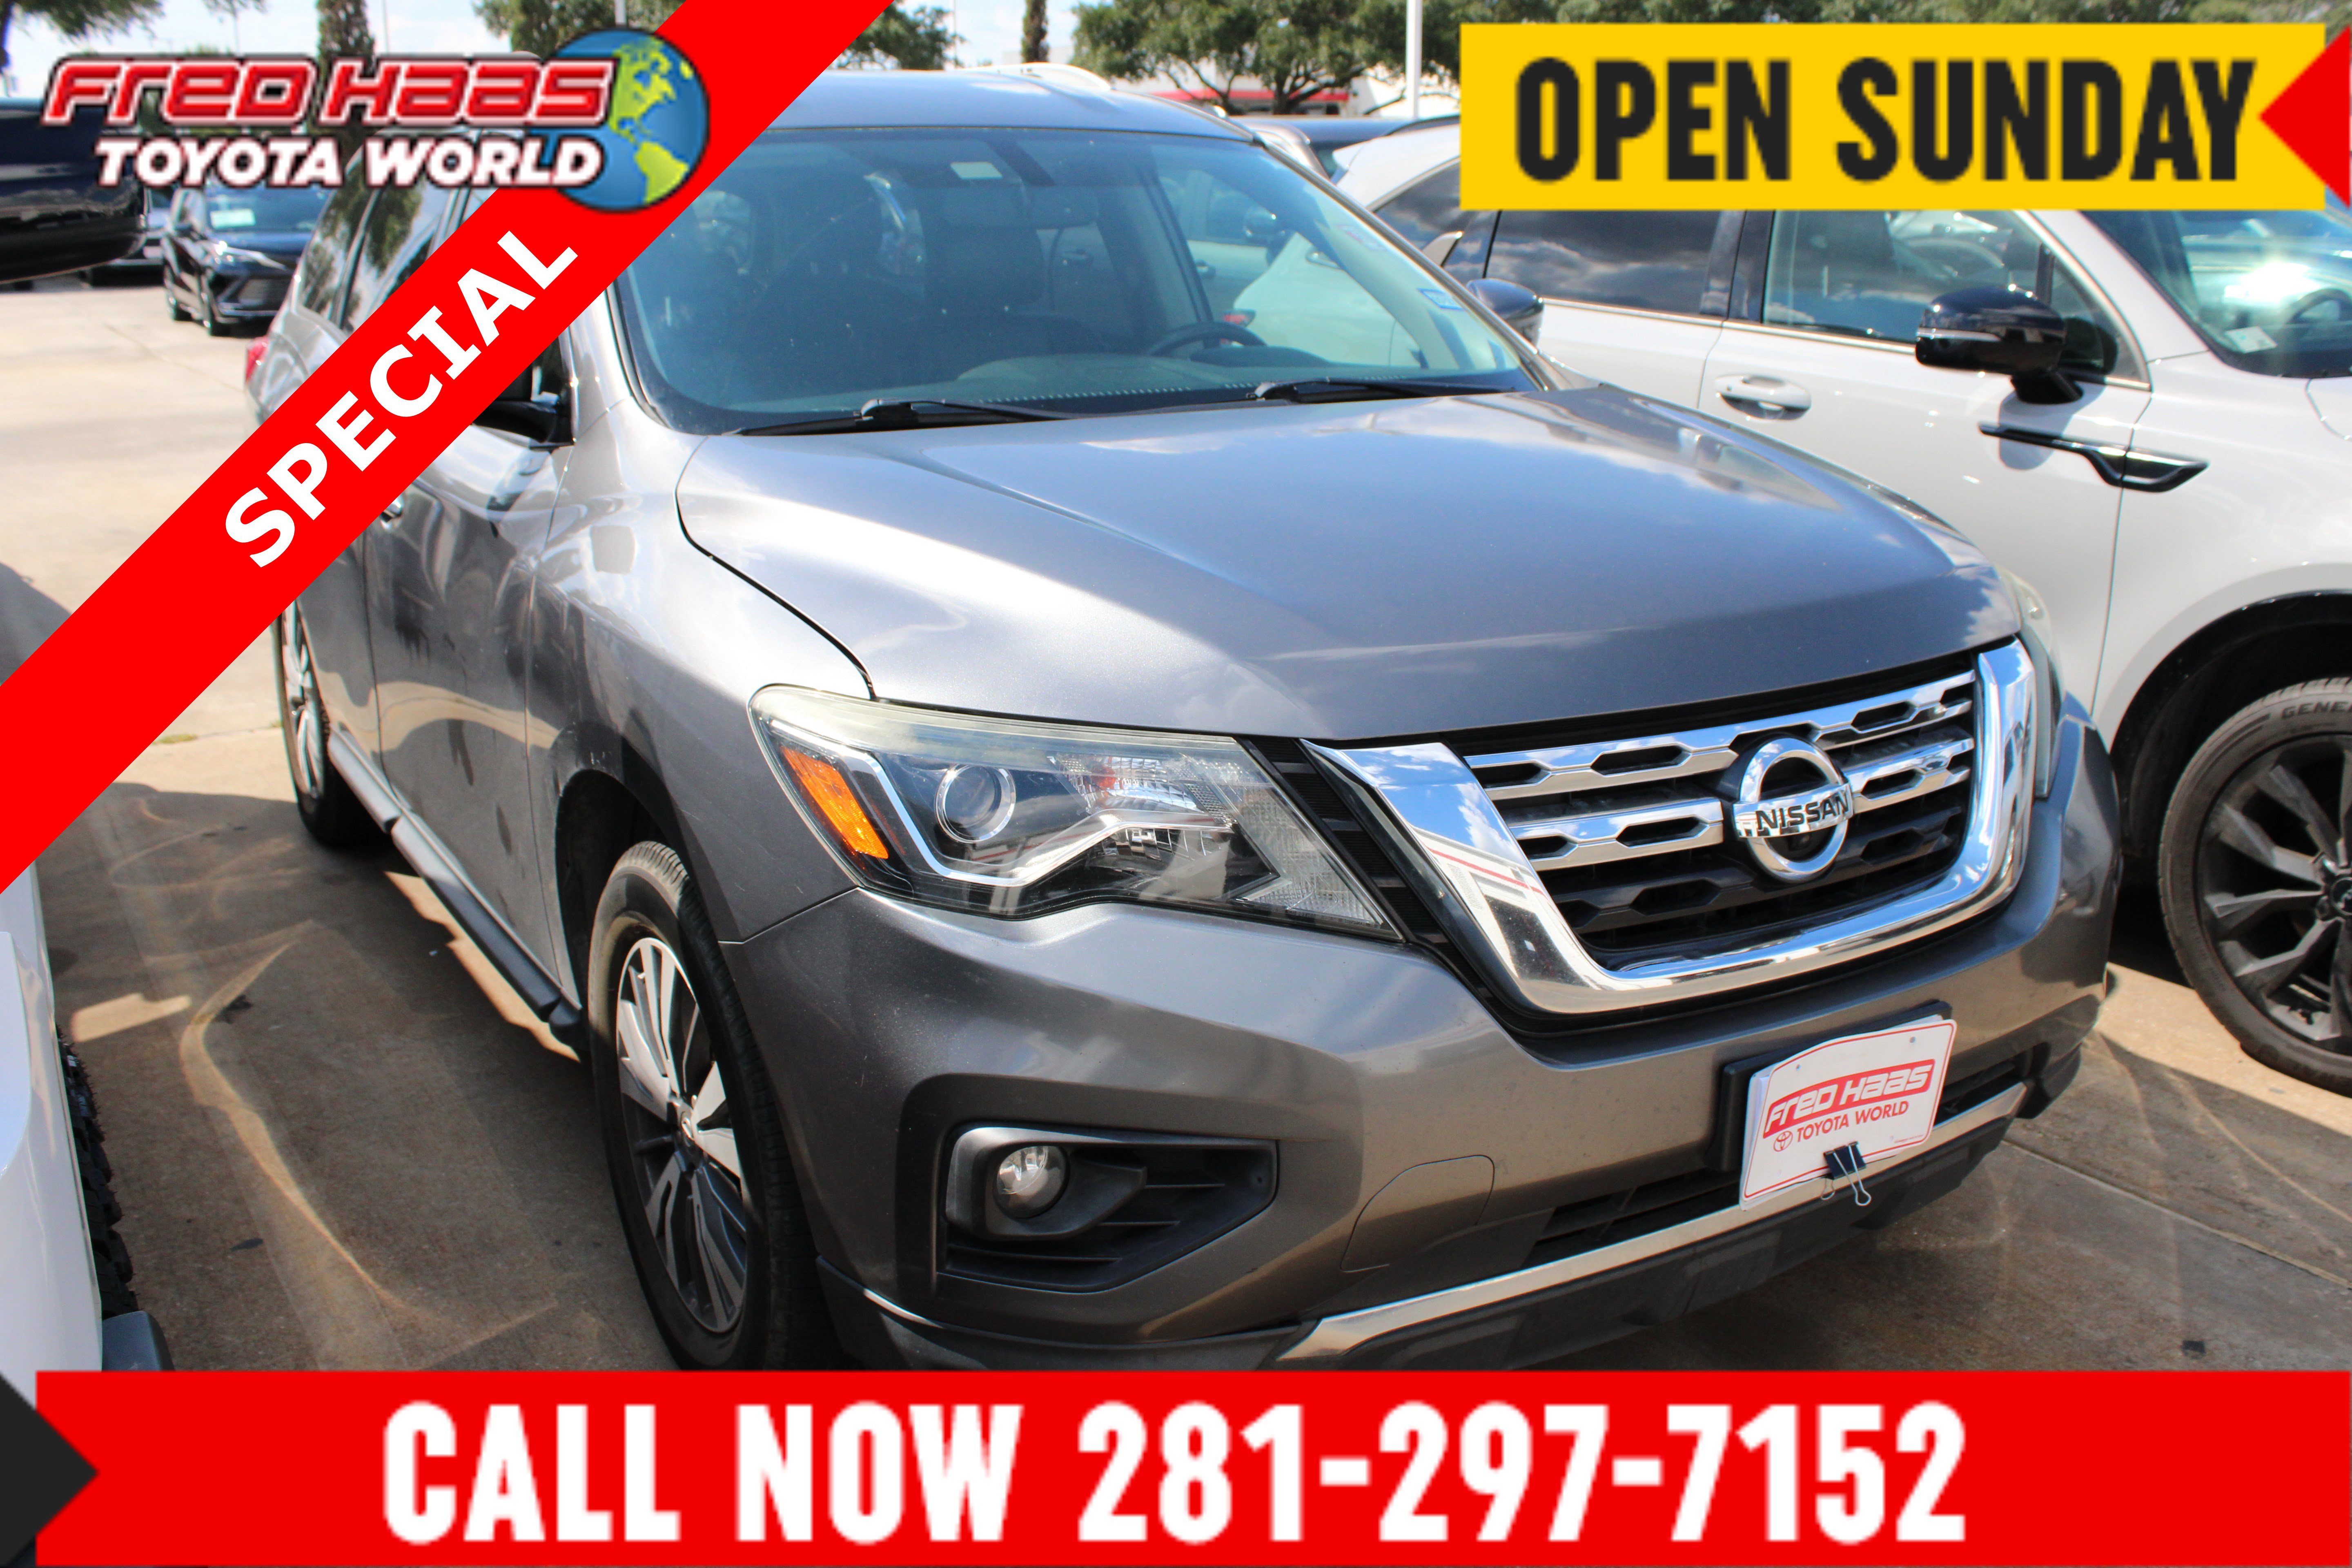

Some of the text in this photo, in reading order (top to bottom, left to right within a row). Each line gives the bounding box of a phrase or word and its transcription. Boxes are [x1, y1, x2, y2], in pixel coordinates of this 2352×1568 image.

[2281, 701, 2352, 719] GENE
[1755, 789, 1849, 830] NISSAN
[1797, 1100, 1909, 1142] TOYOTA WORLD
